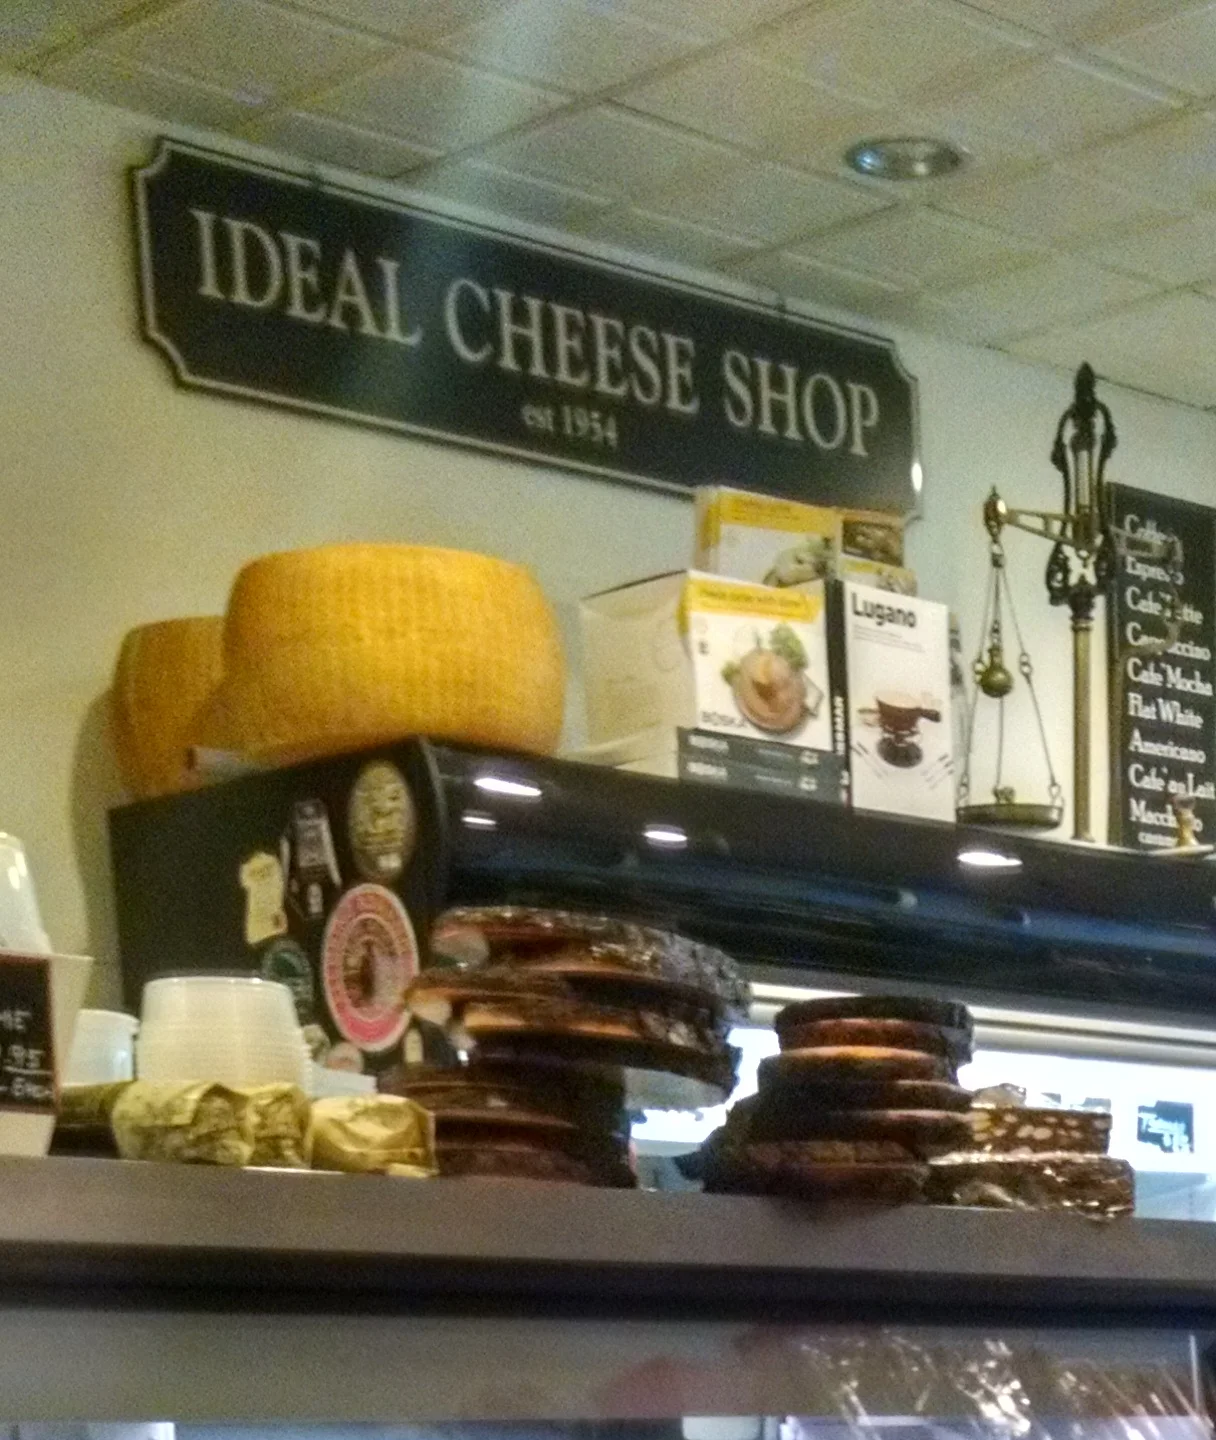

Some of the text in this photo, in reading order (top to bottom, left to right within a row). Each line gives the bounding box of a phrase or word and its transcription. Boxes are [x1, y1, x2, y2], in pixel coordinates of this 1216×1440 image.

[189, 208, 880, 457] IDEAL CHEESE SHOP
[521, 404, 618, 447] est 1954
[851, 592, 917, 628] Lugano
[1128, 692, 1157, 720] Flat
[1157, 698, 1203, 729] White
[1128, 728, 1206, 764] Americano
